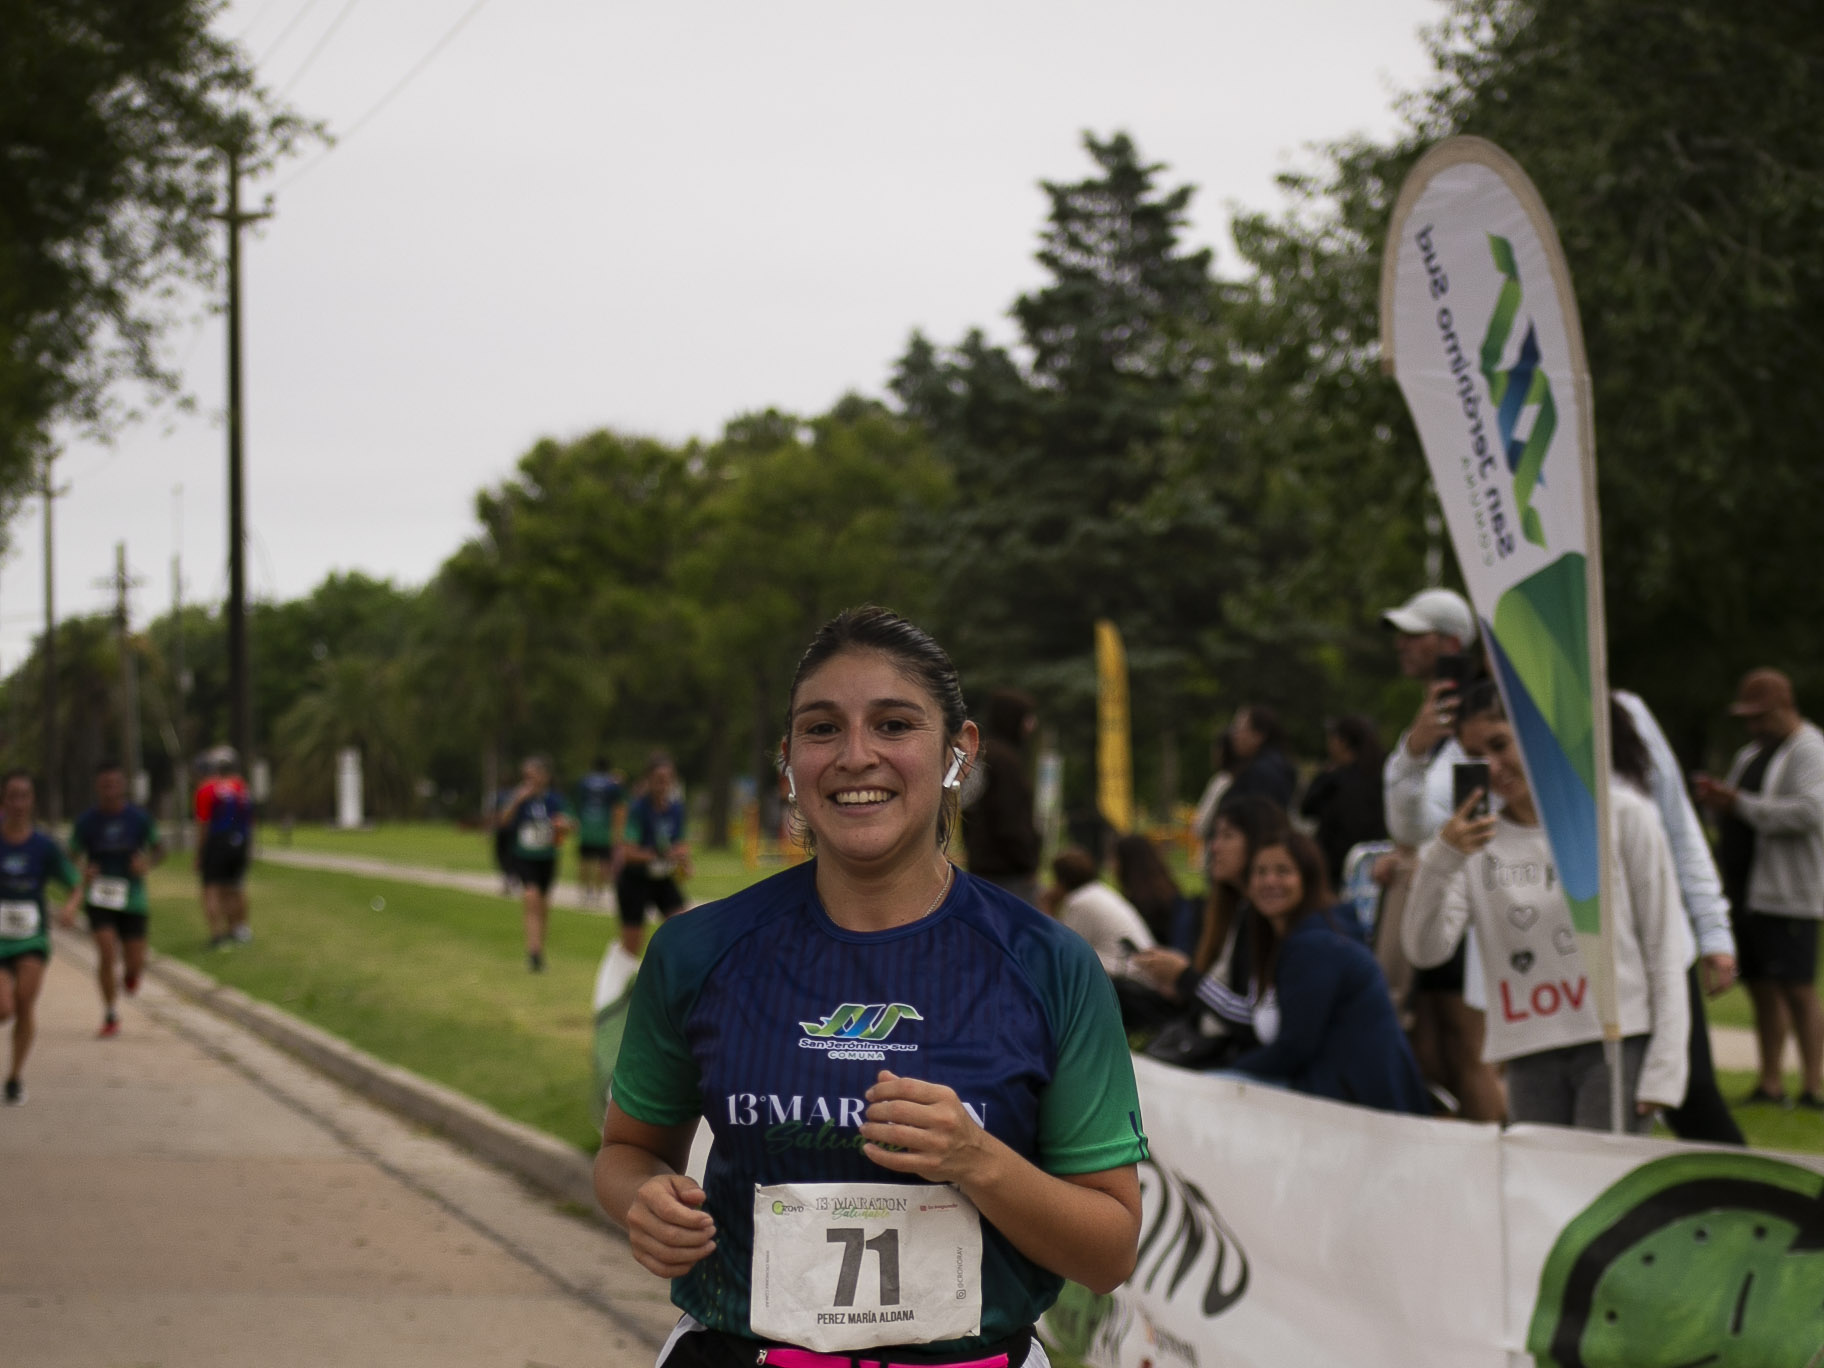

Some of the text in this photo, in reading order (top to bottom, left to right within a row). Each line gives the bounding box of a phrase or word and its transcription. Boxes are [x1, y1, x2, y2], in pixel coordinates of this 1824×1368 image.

[799, 1038, 918, 1051] San Jerónimo Sud
[828, 1050, 886, 1061] COMUNA
[768, 1094, 987, 1129] MARN
[826, 1228, 901, 1307] 71
[817, 1309, 915, 1325] PEREZ MARÍA ALDANA
